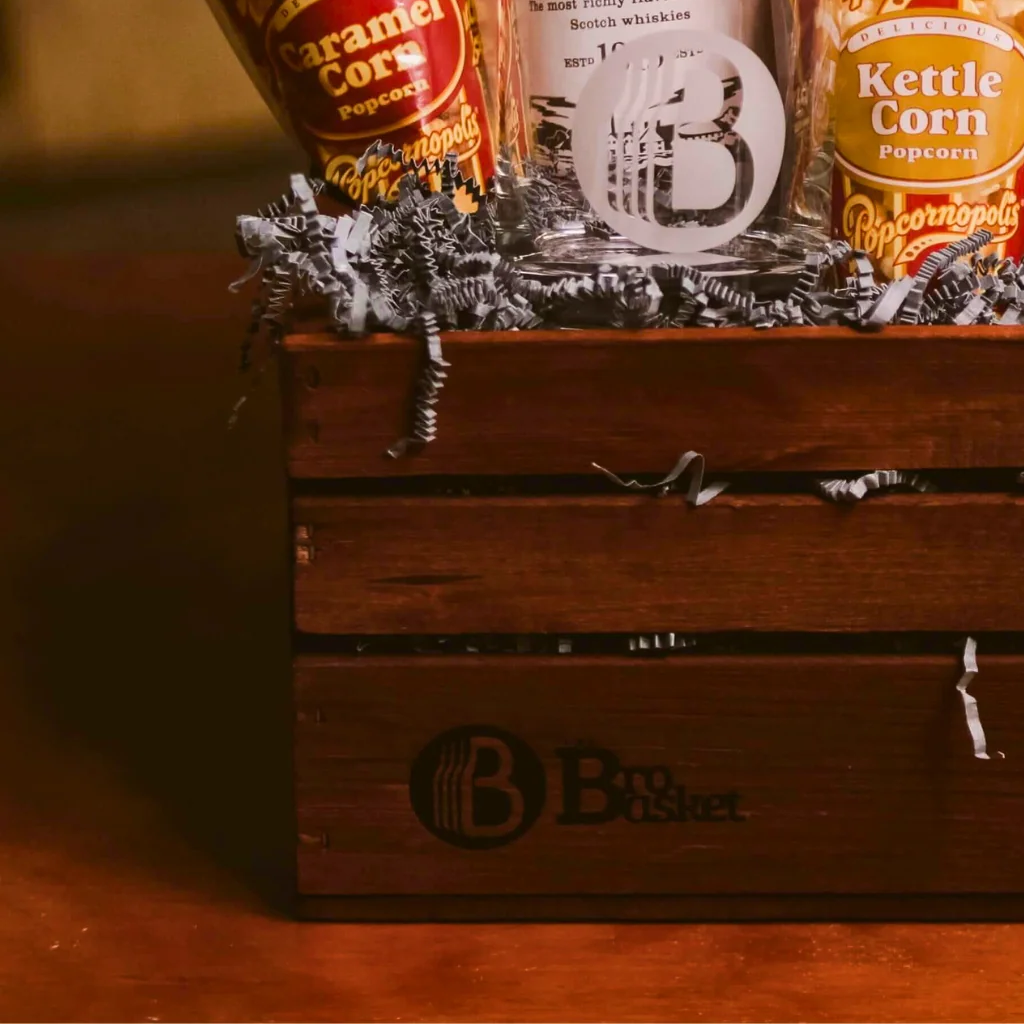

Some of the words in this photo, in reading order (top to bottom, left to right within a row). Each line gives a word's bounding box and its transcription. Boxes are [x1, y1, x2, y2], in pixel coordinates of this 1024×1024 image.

[529, 0, 544, 12] The
[570, 16, 616, 31] Scotch
[622, 9, 691, 26] whiskies
[860, 21, 1001, 42] DELICIOUS
[318, 39, 426, 97] Corn
[564, 56, 595, 69] ESTD
[857, 61, 1002, 98] Kettle
[337, 78, 429, 121] Popcorn
[871, 100, 989, 136] Corn
[879, 144, 978, 163] Popcorn
[843, 188, 1021, 259] Popcornopolis
